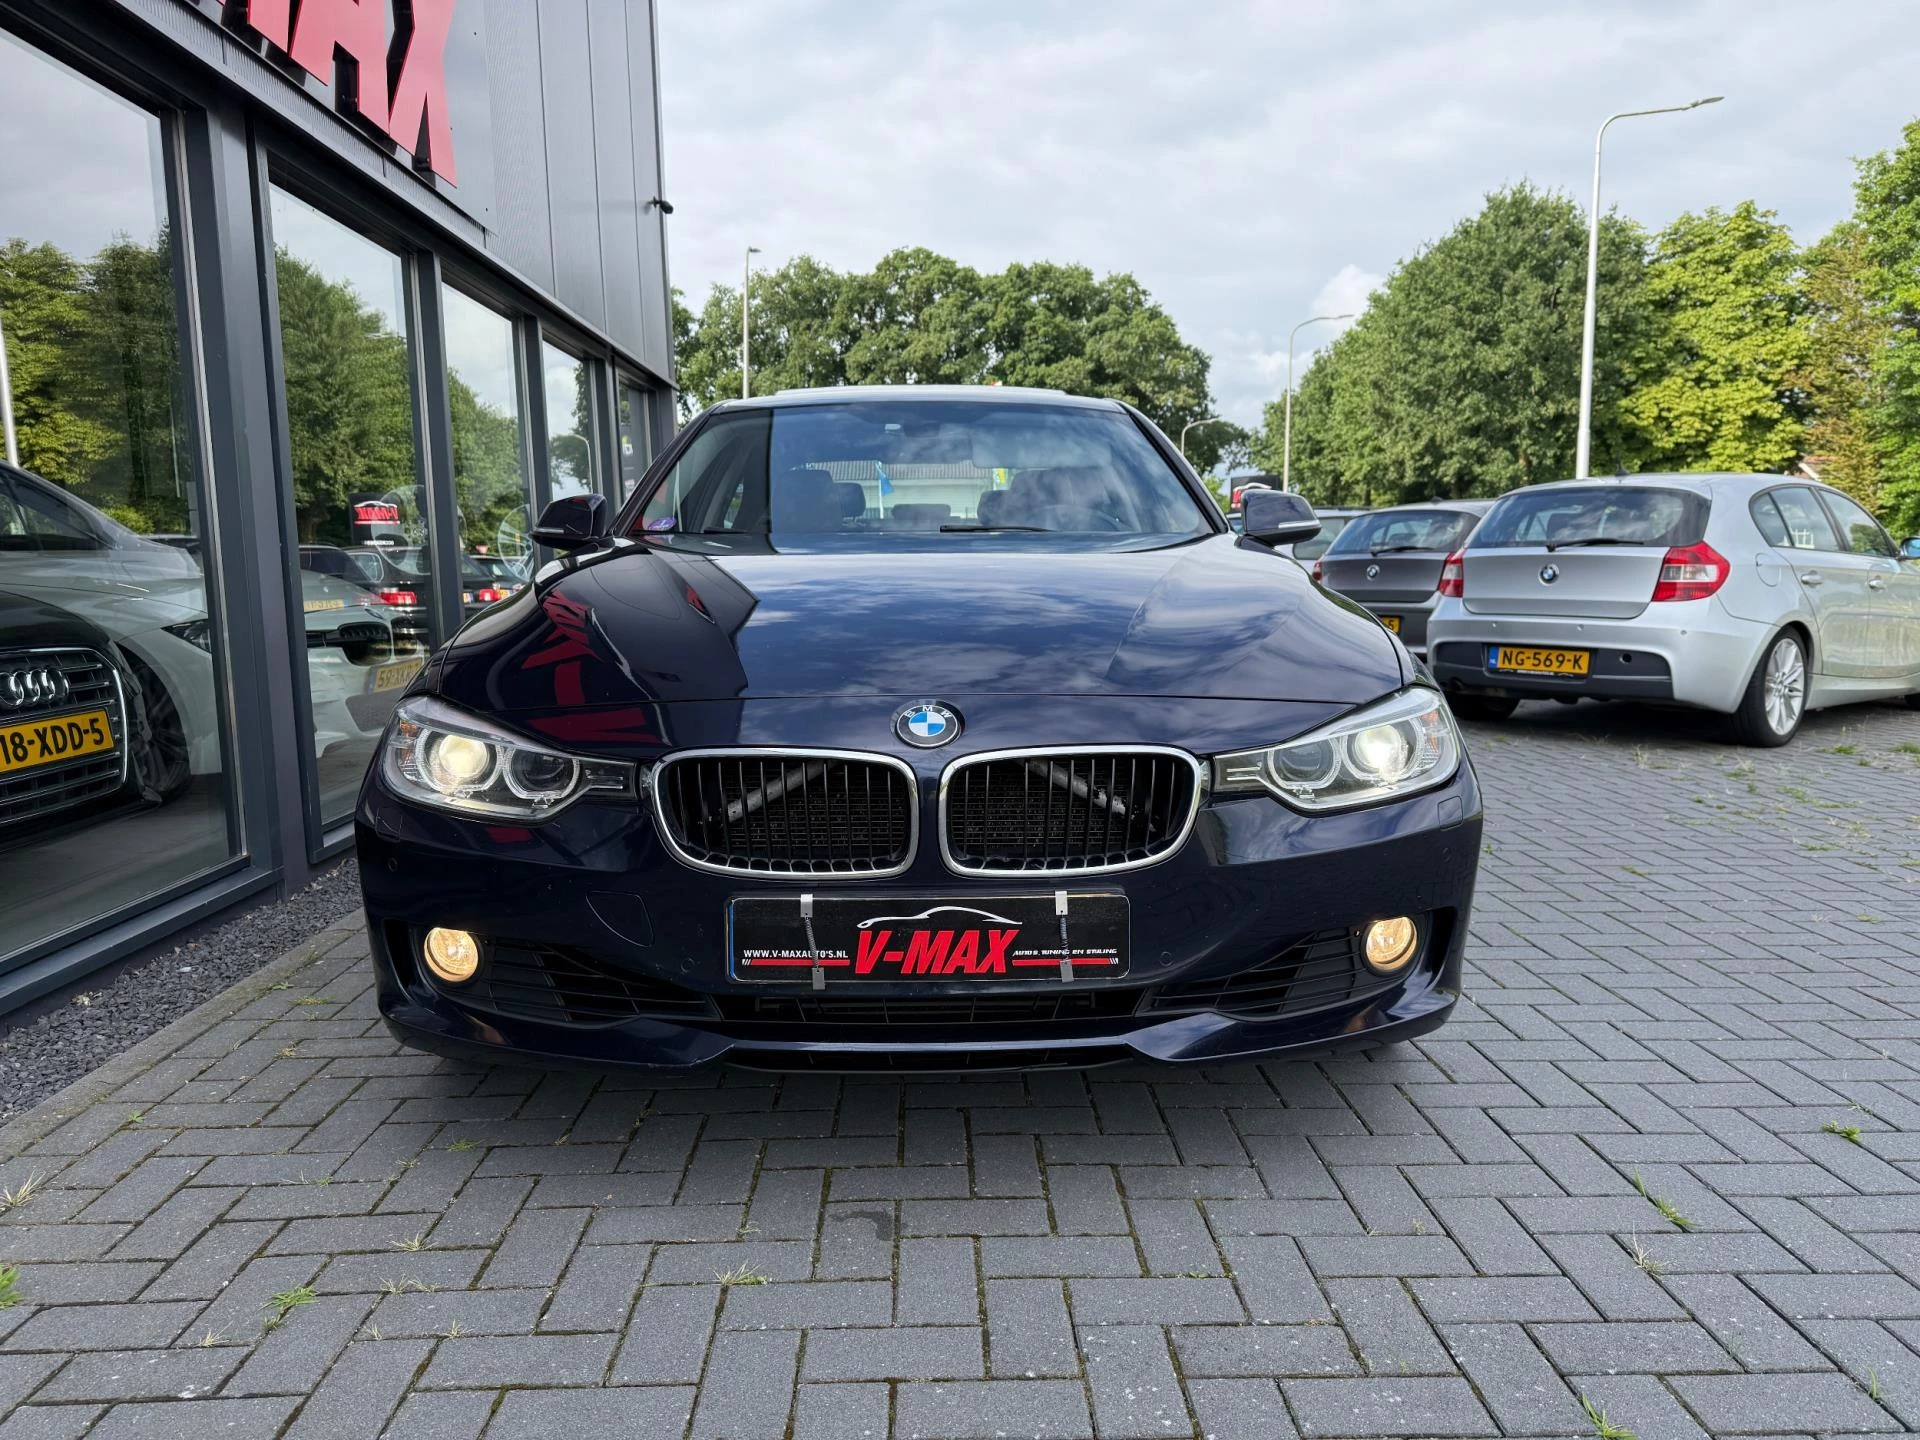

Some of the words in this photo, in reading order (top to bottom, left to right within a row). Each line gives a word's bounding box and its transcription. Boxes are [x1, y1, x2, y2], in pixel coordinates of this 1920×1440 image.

[1502, 649, 1583, 671] NG-569-K
[903, 704, 953, 718] BMW
[0, 717, 105, 765] 18-XDD-5
[855, 929, 1020, 974] V-MAX
